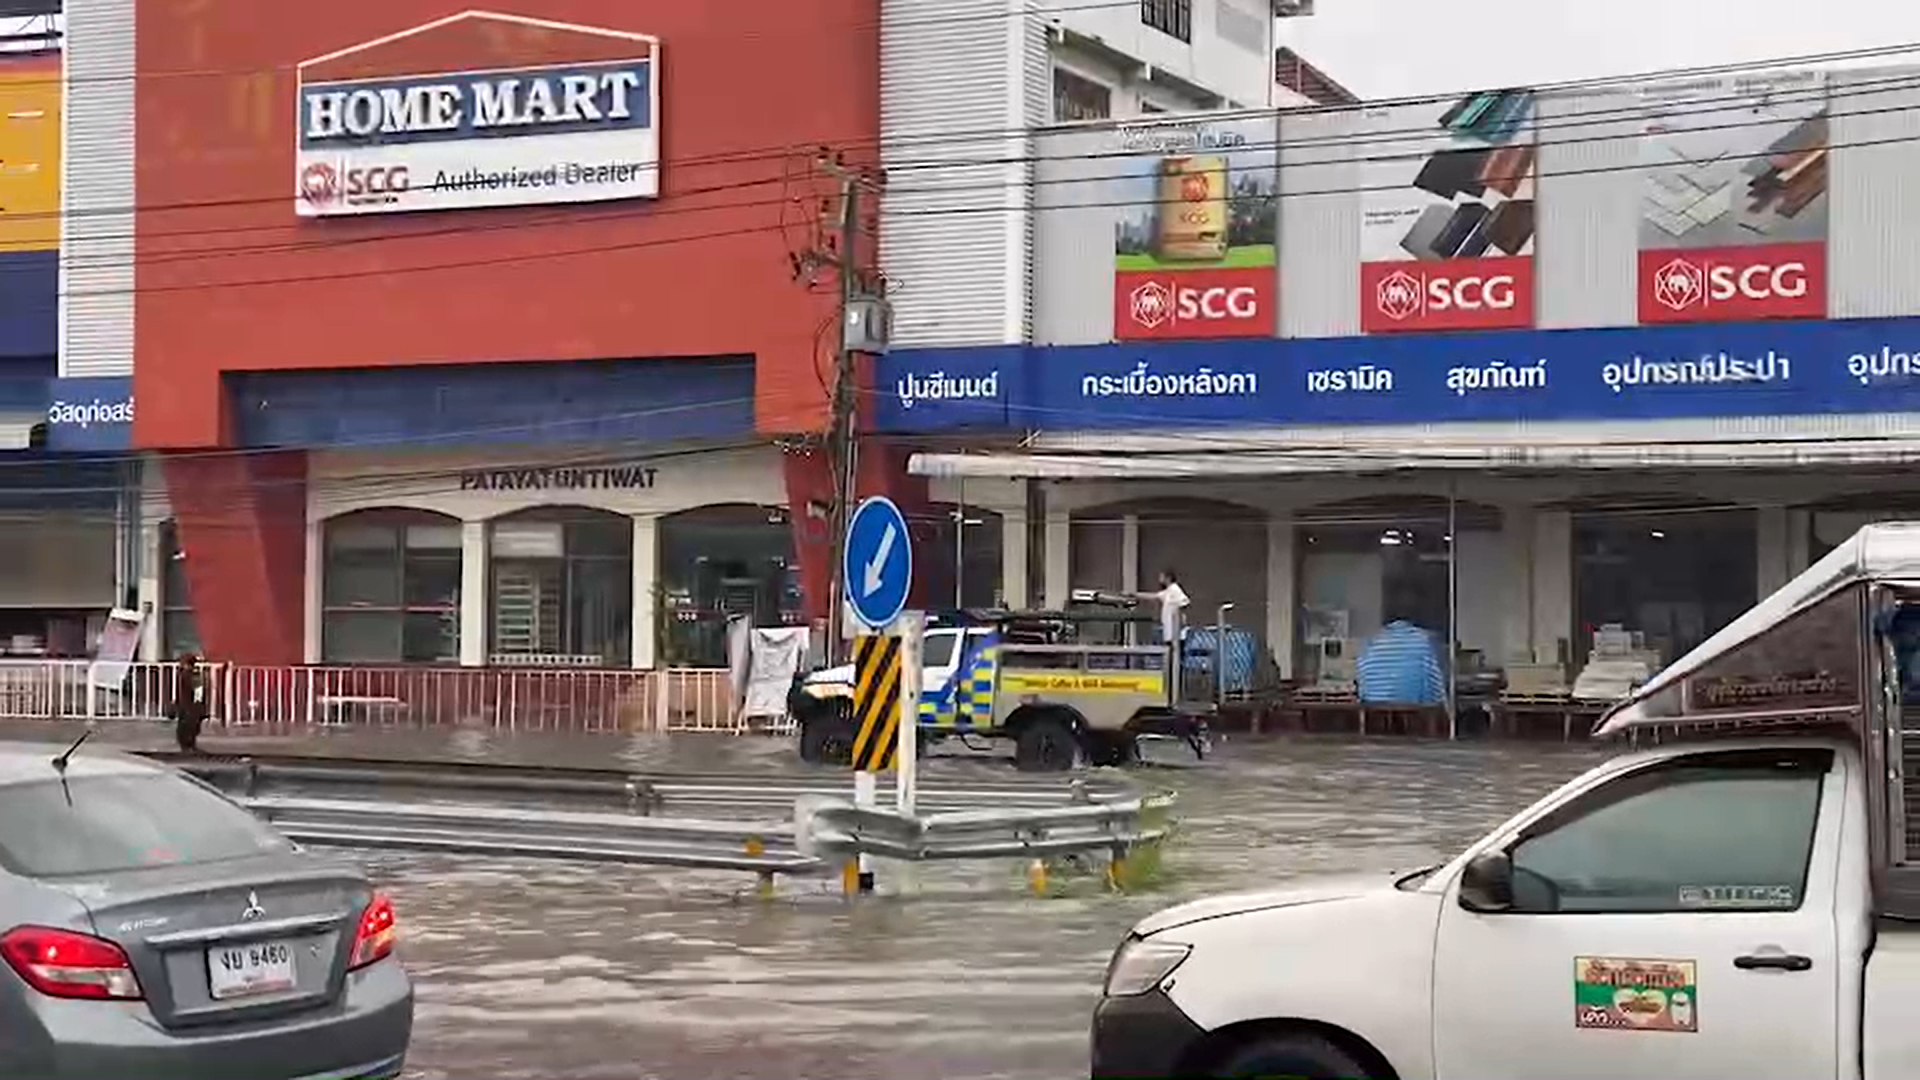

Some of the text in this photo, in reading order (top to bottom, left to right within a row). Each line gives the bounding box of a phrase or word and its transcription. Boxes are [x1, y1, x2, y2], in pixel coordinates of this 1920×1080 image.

[307, 71, 639, 139] HOME MART
[347, 166, 410, 195] SCG
[433, 159, 639, 194] Authorized Dealer
[1428, 275, 1516, 310] SCG
[1710, 262, 1808, 300] SCG
[1177, 286, 1257, 319] SCG
[898, 370, 998, 409] ปูนซีเมนต์
[1082, 361, 1257, 396] กระเบื้องหลังคา
[1307, 365, 1392, 392] เซรามิค
[1446, 358, 1547, 396] สุขภัณฑ์
